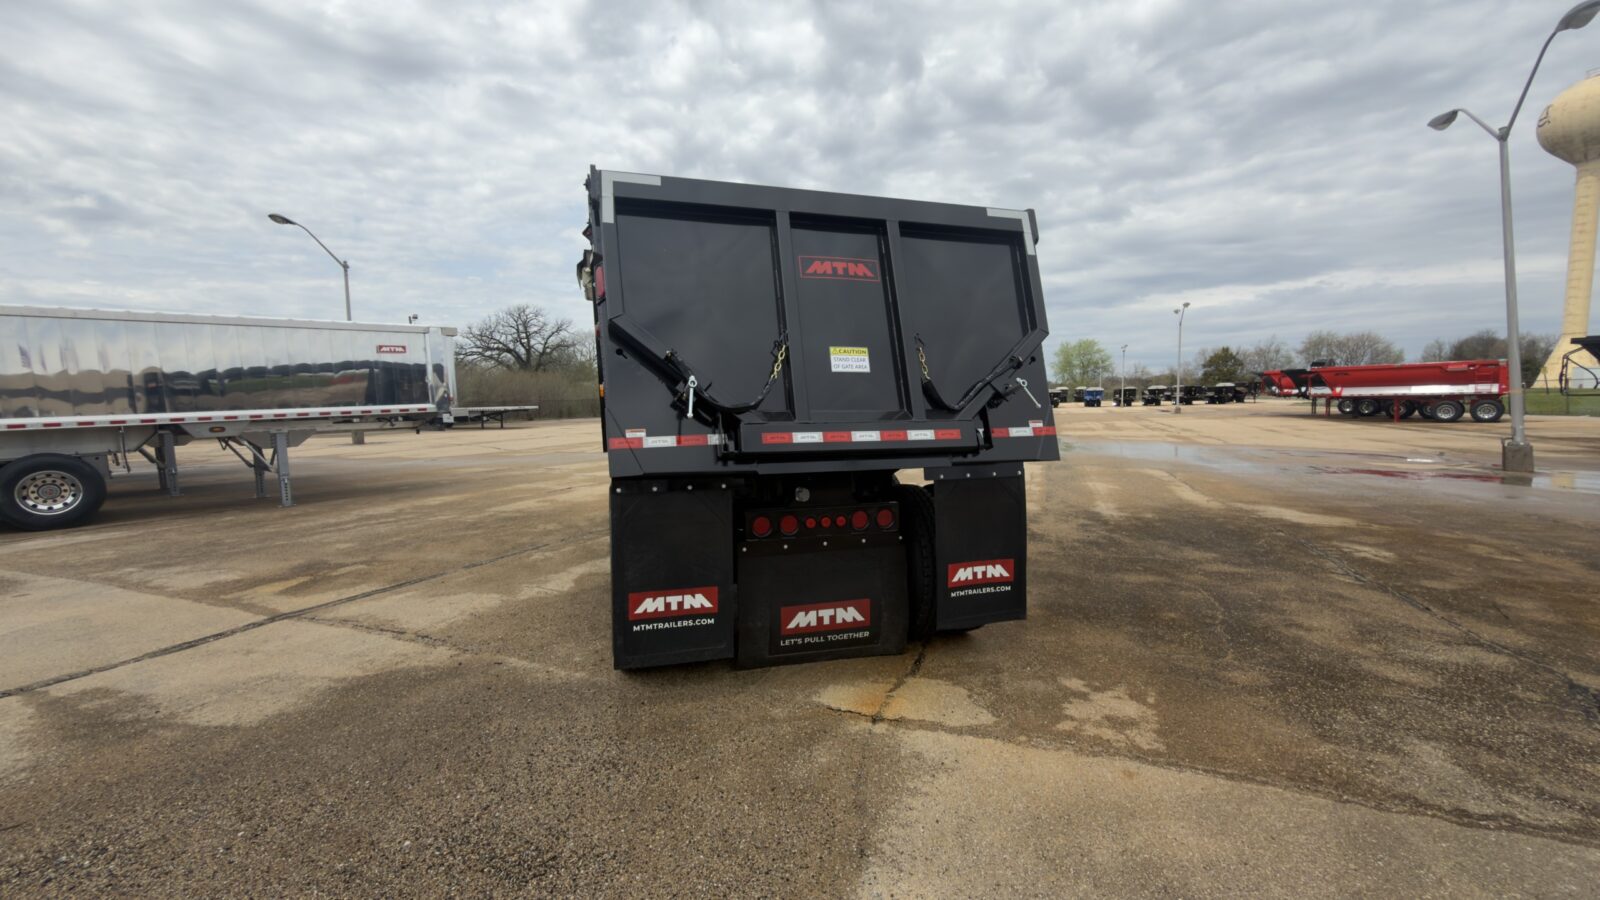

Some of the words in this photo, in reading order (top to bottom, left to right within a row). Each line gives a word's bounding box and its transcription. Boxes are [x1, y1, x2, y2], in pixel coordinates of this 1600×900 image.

[807, 261, 874, 277] MTM
[951, 564, 1010, 582] MTM
[951, 586, 1011, 597] MTMTRAILERS.COM
[634, 593, 713, 614] MTM
[633, 618, 715, 632] MTMTRAILERS.COM
[786, 606, 865, 629] MTM
[780, 637, 802, 647] LET'S
[804, 635, 825, 644] PULL
[827, 631, 870, 641] TOGETHER
